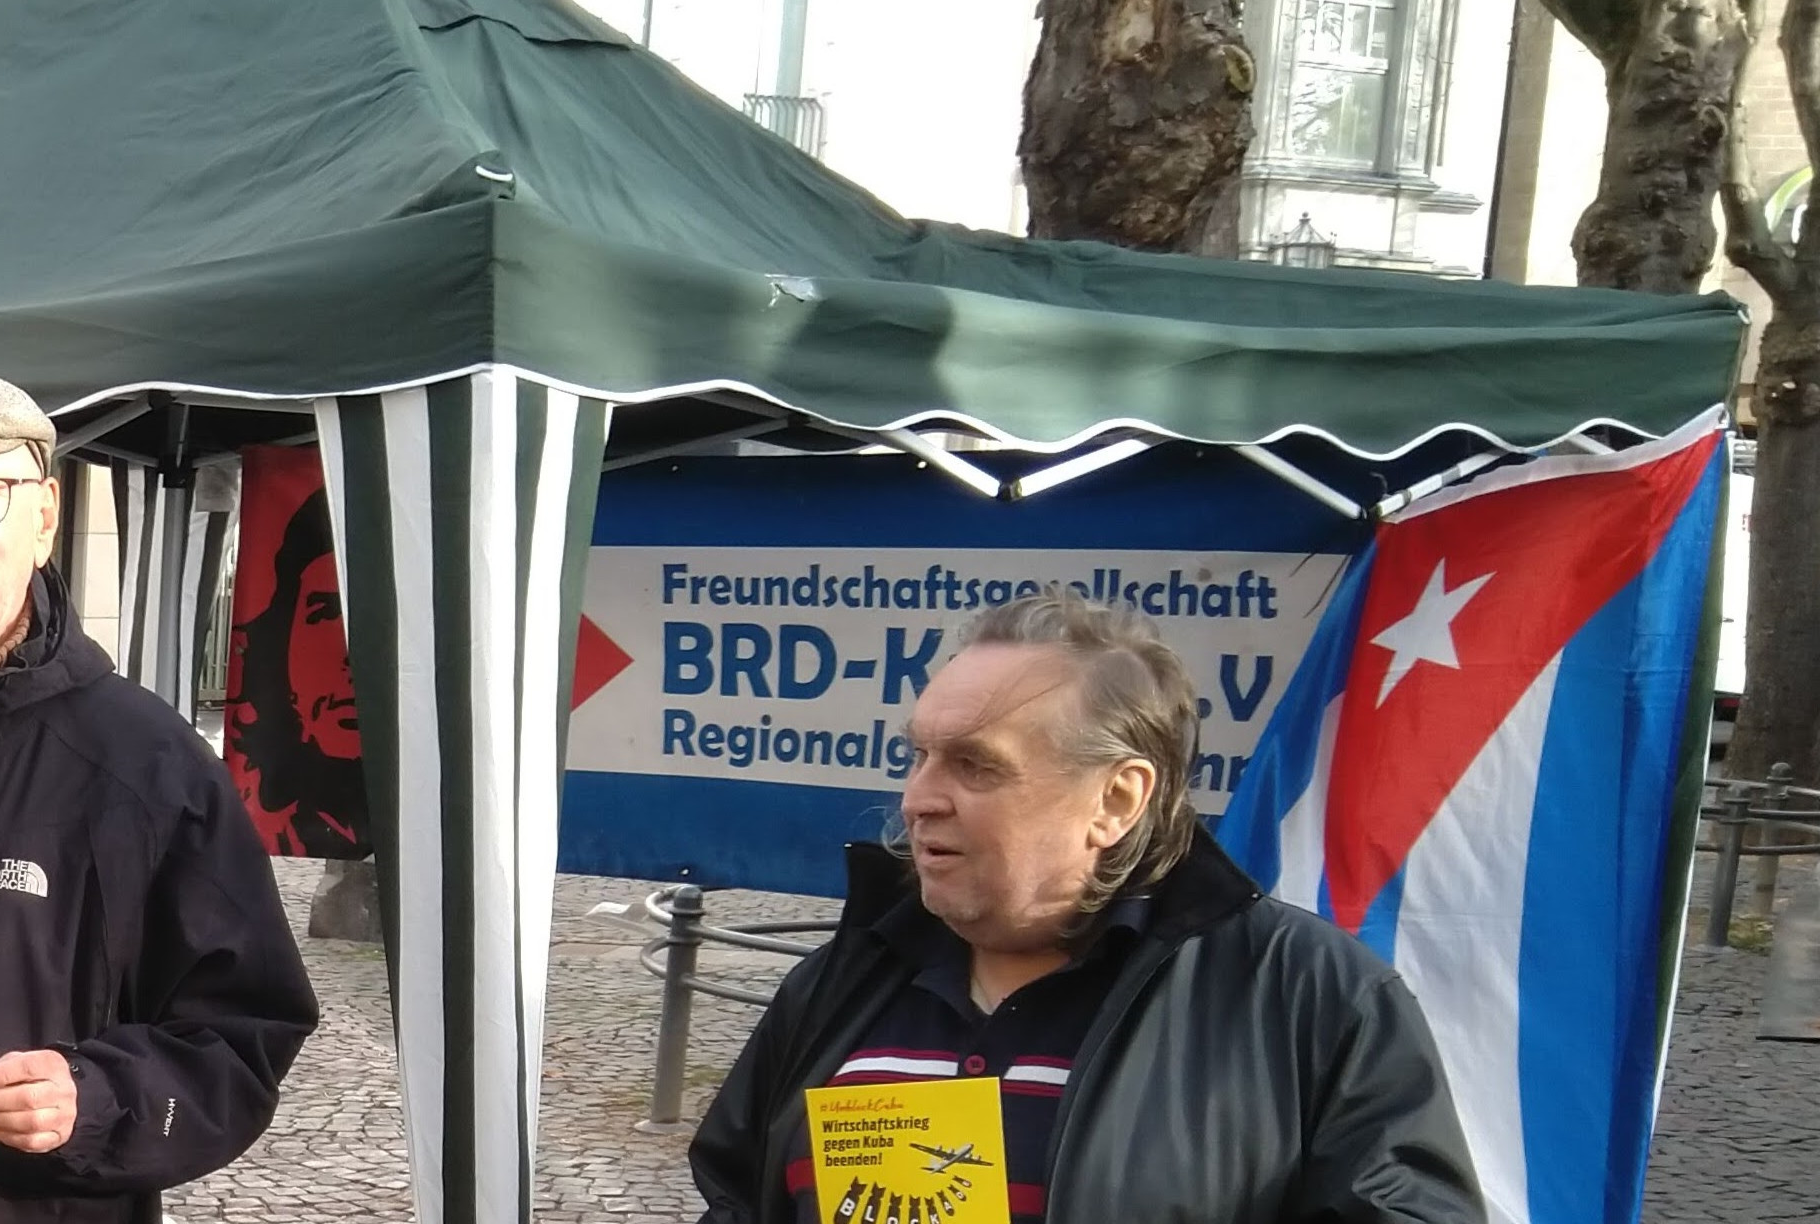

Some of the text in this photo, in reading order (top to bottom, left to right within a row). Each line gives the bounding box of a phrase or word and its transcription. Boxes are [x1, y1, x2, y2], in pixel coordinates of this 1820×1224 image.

[662, 621, 946, 705] BRD-K
[662, 708, 916, 779] Regionalg
[2, 858, 28, 871] THE
[822, 1116, 930, 1133] Wirtschaftskrieg
[824, 1136, 894, 1152] gegen Kuba
[825, 1153, 883, 1167] beenden!
